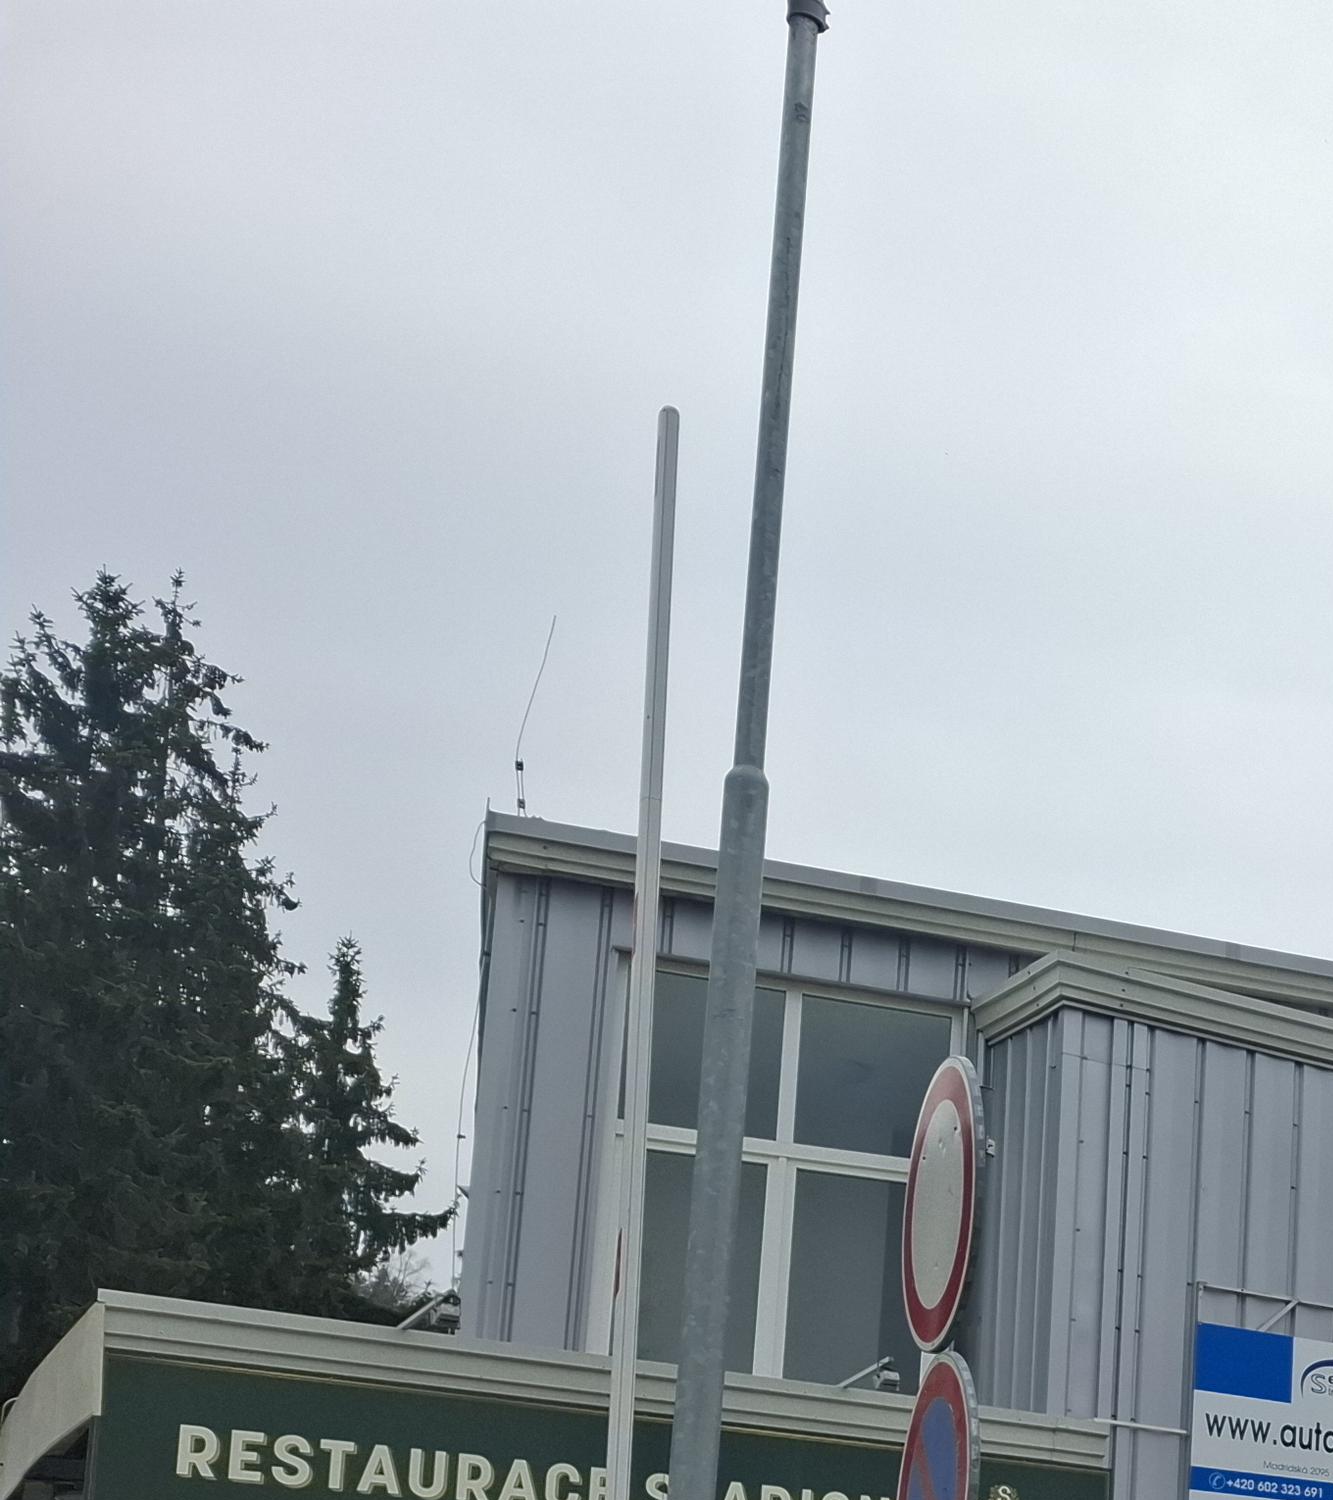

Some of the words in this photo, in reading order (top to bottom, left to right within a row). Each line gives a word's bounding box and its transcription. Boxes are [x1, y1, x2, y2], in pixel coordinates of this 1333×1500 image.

[1227, 1478, 1254, 1491] +420
[1257, 1481, 1279, 1494] 602
[1281, 1484, 1301, 1496] 323
[1304, 1486, 1323, 1499] 691
